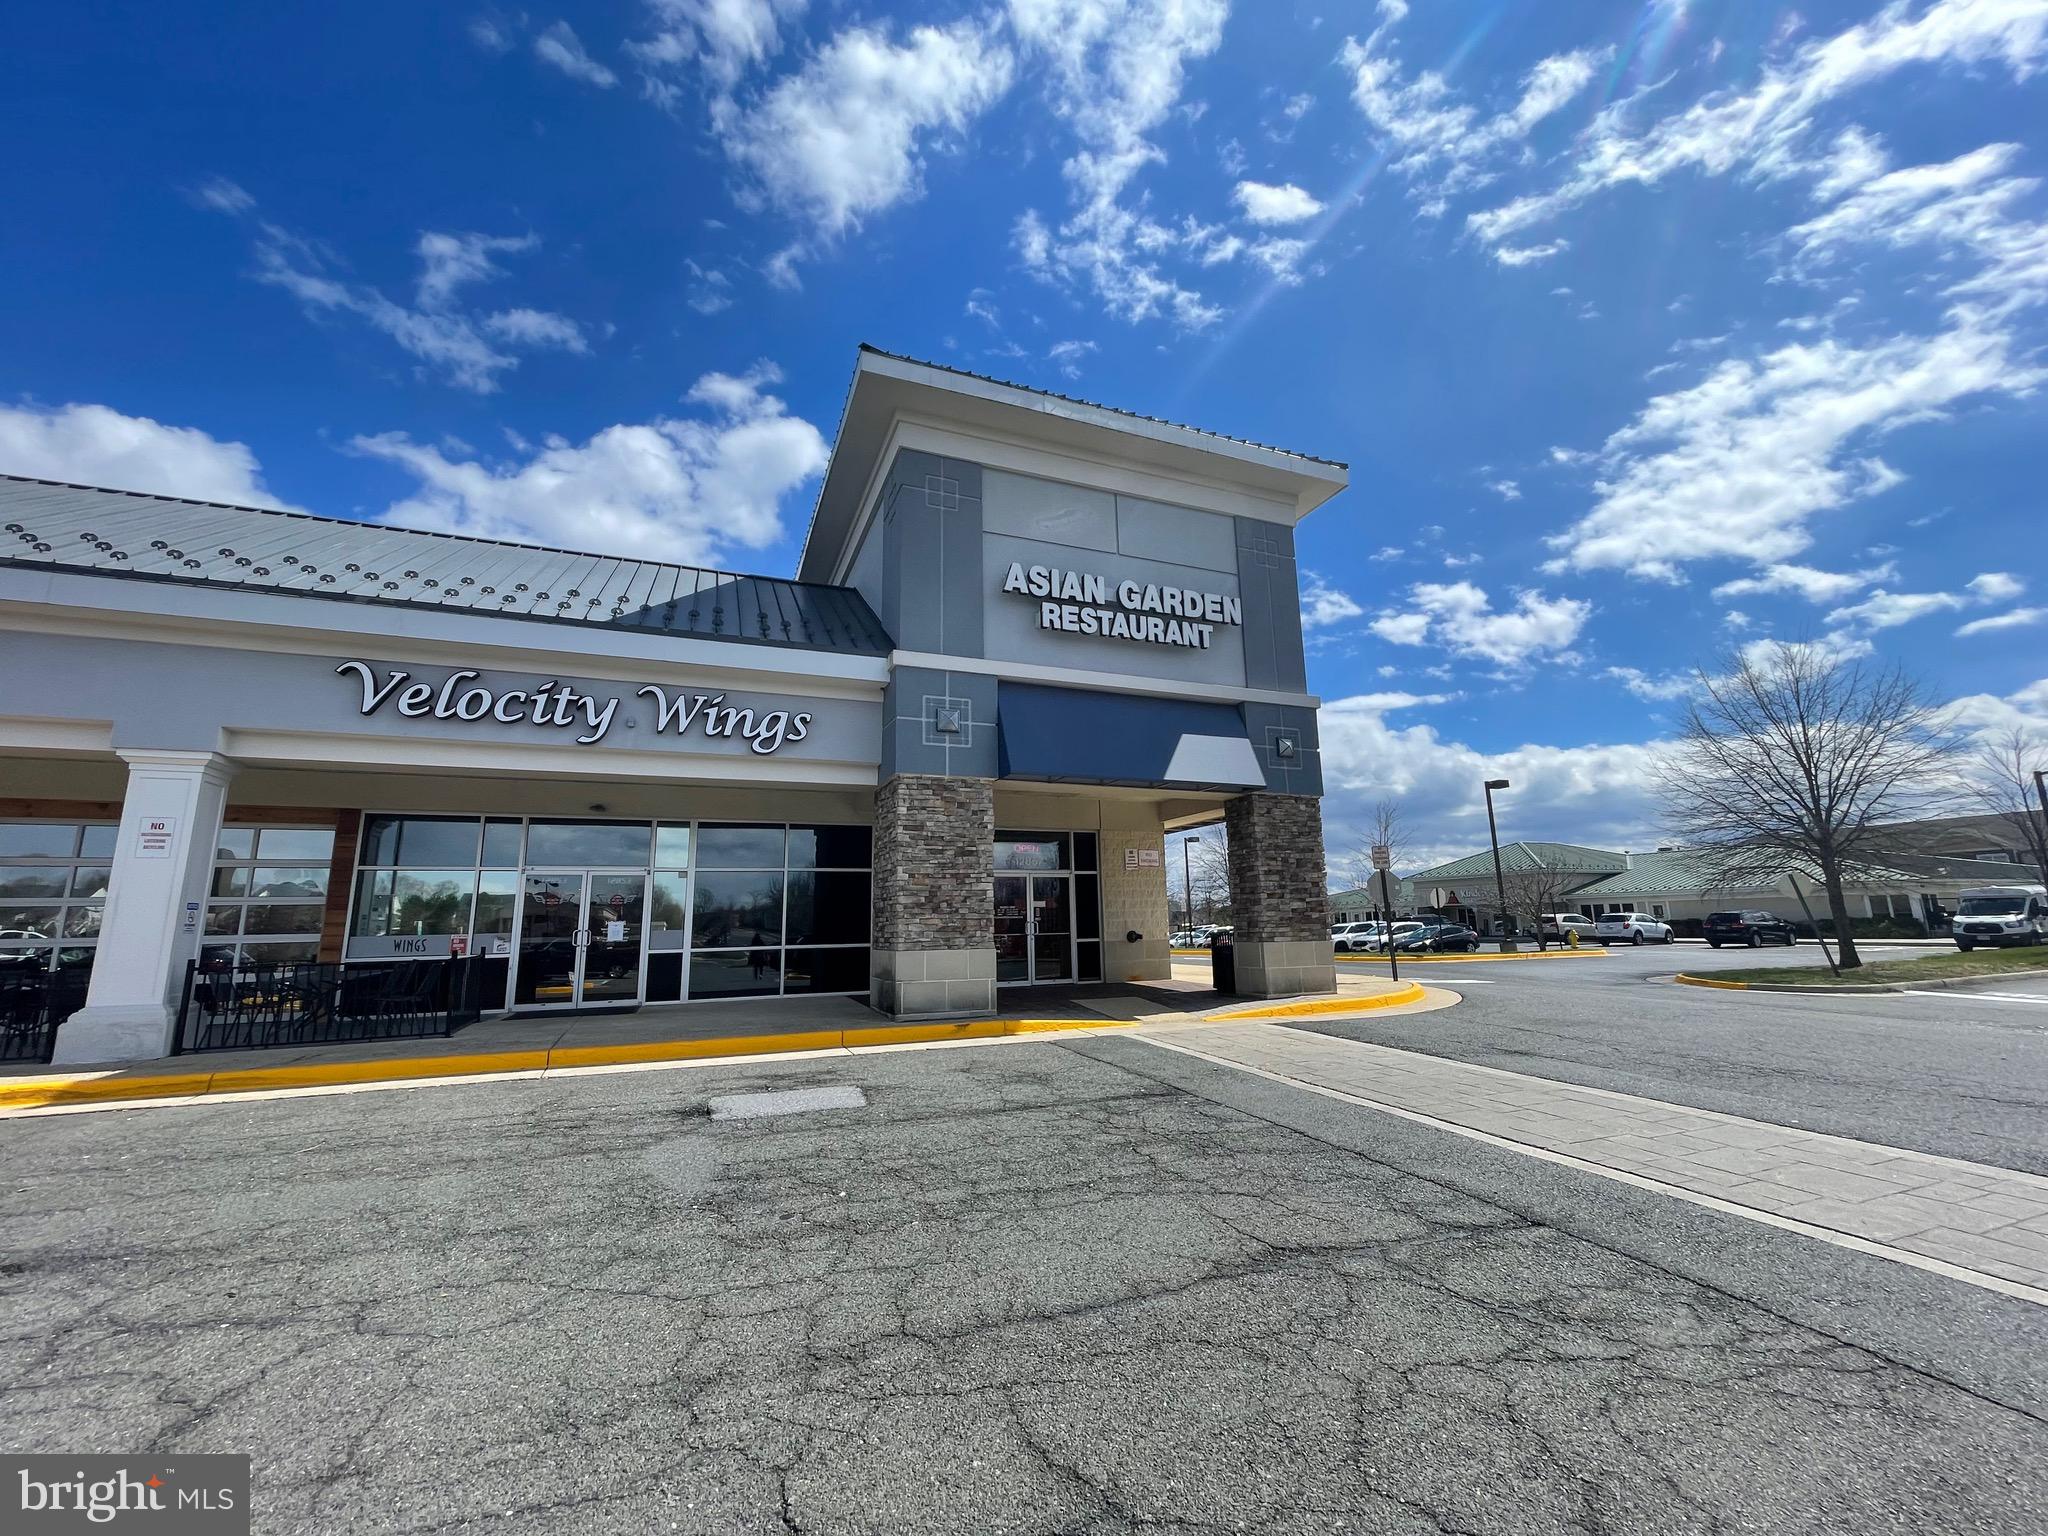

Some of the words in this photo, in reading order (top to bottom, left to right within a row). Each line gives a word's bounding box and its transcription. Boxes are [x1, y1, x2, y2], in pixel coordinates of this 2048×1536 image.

[1002, 562, 1106, 605] ASIAN
[1116, 579, 1243, 626] GARDEN
[1040, 602, 1213, 649] RESTAURANT
[335, 661, 619, 744] Velocity
[637, 684, 812, 755] Wings
[150, 822, 165, 830] NO
[1014, 844, 1040, 853] OPEN
[393, 938, 428, 953] WINGS
